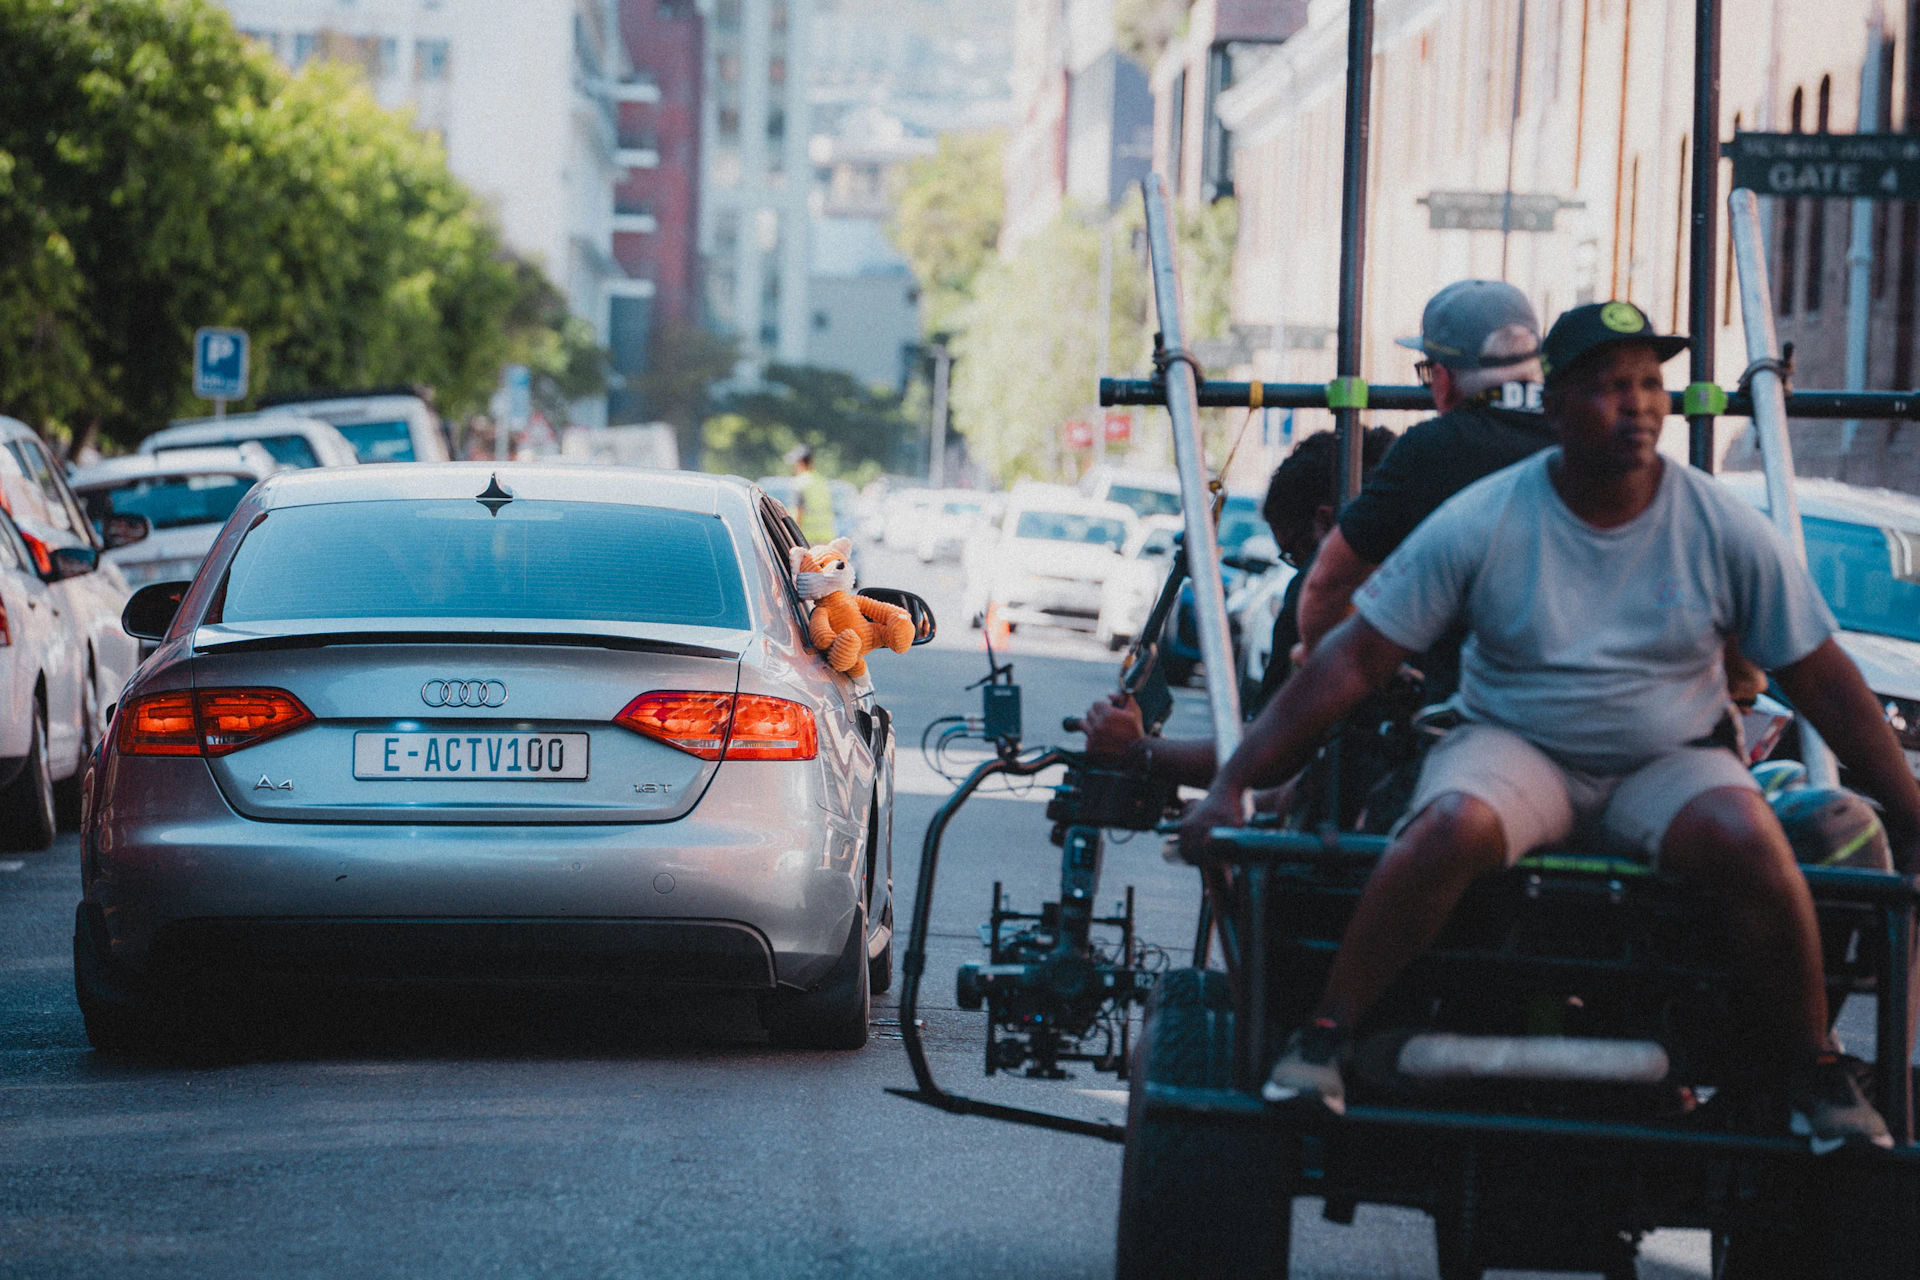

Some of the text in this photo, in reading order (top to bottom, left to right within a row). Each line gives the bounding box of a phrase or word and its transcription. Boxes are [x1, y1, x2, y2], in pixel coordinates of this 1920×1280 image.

[1768, 162, 1898, 192] GATE 4
[207, 335, 235, 366] P
[384, 738, 563, 772] E-ACTV100
[253, 774, 294, 791] A4
